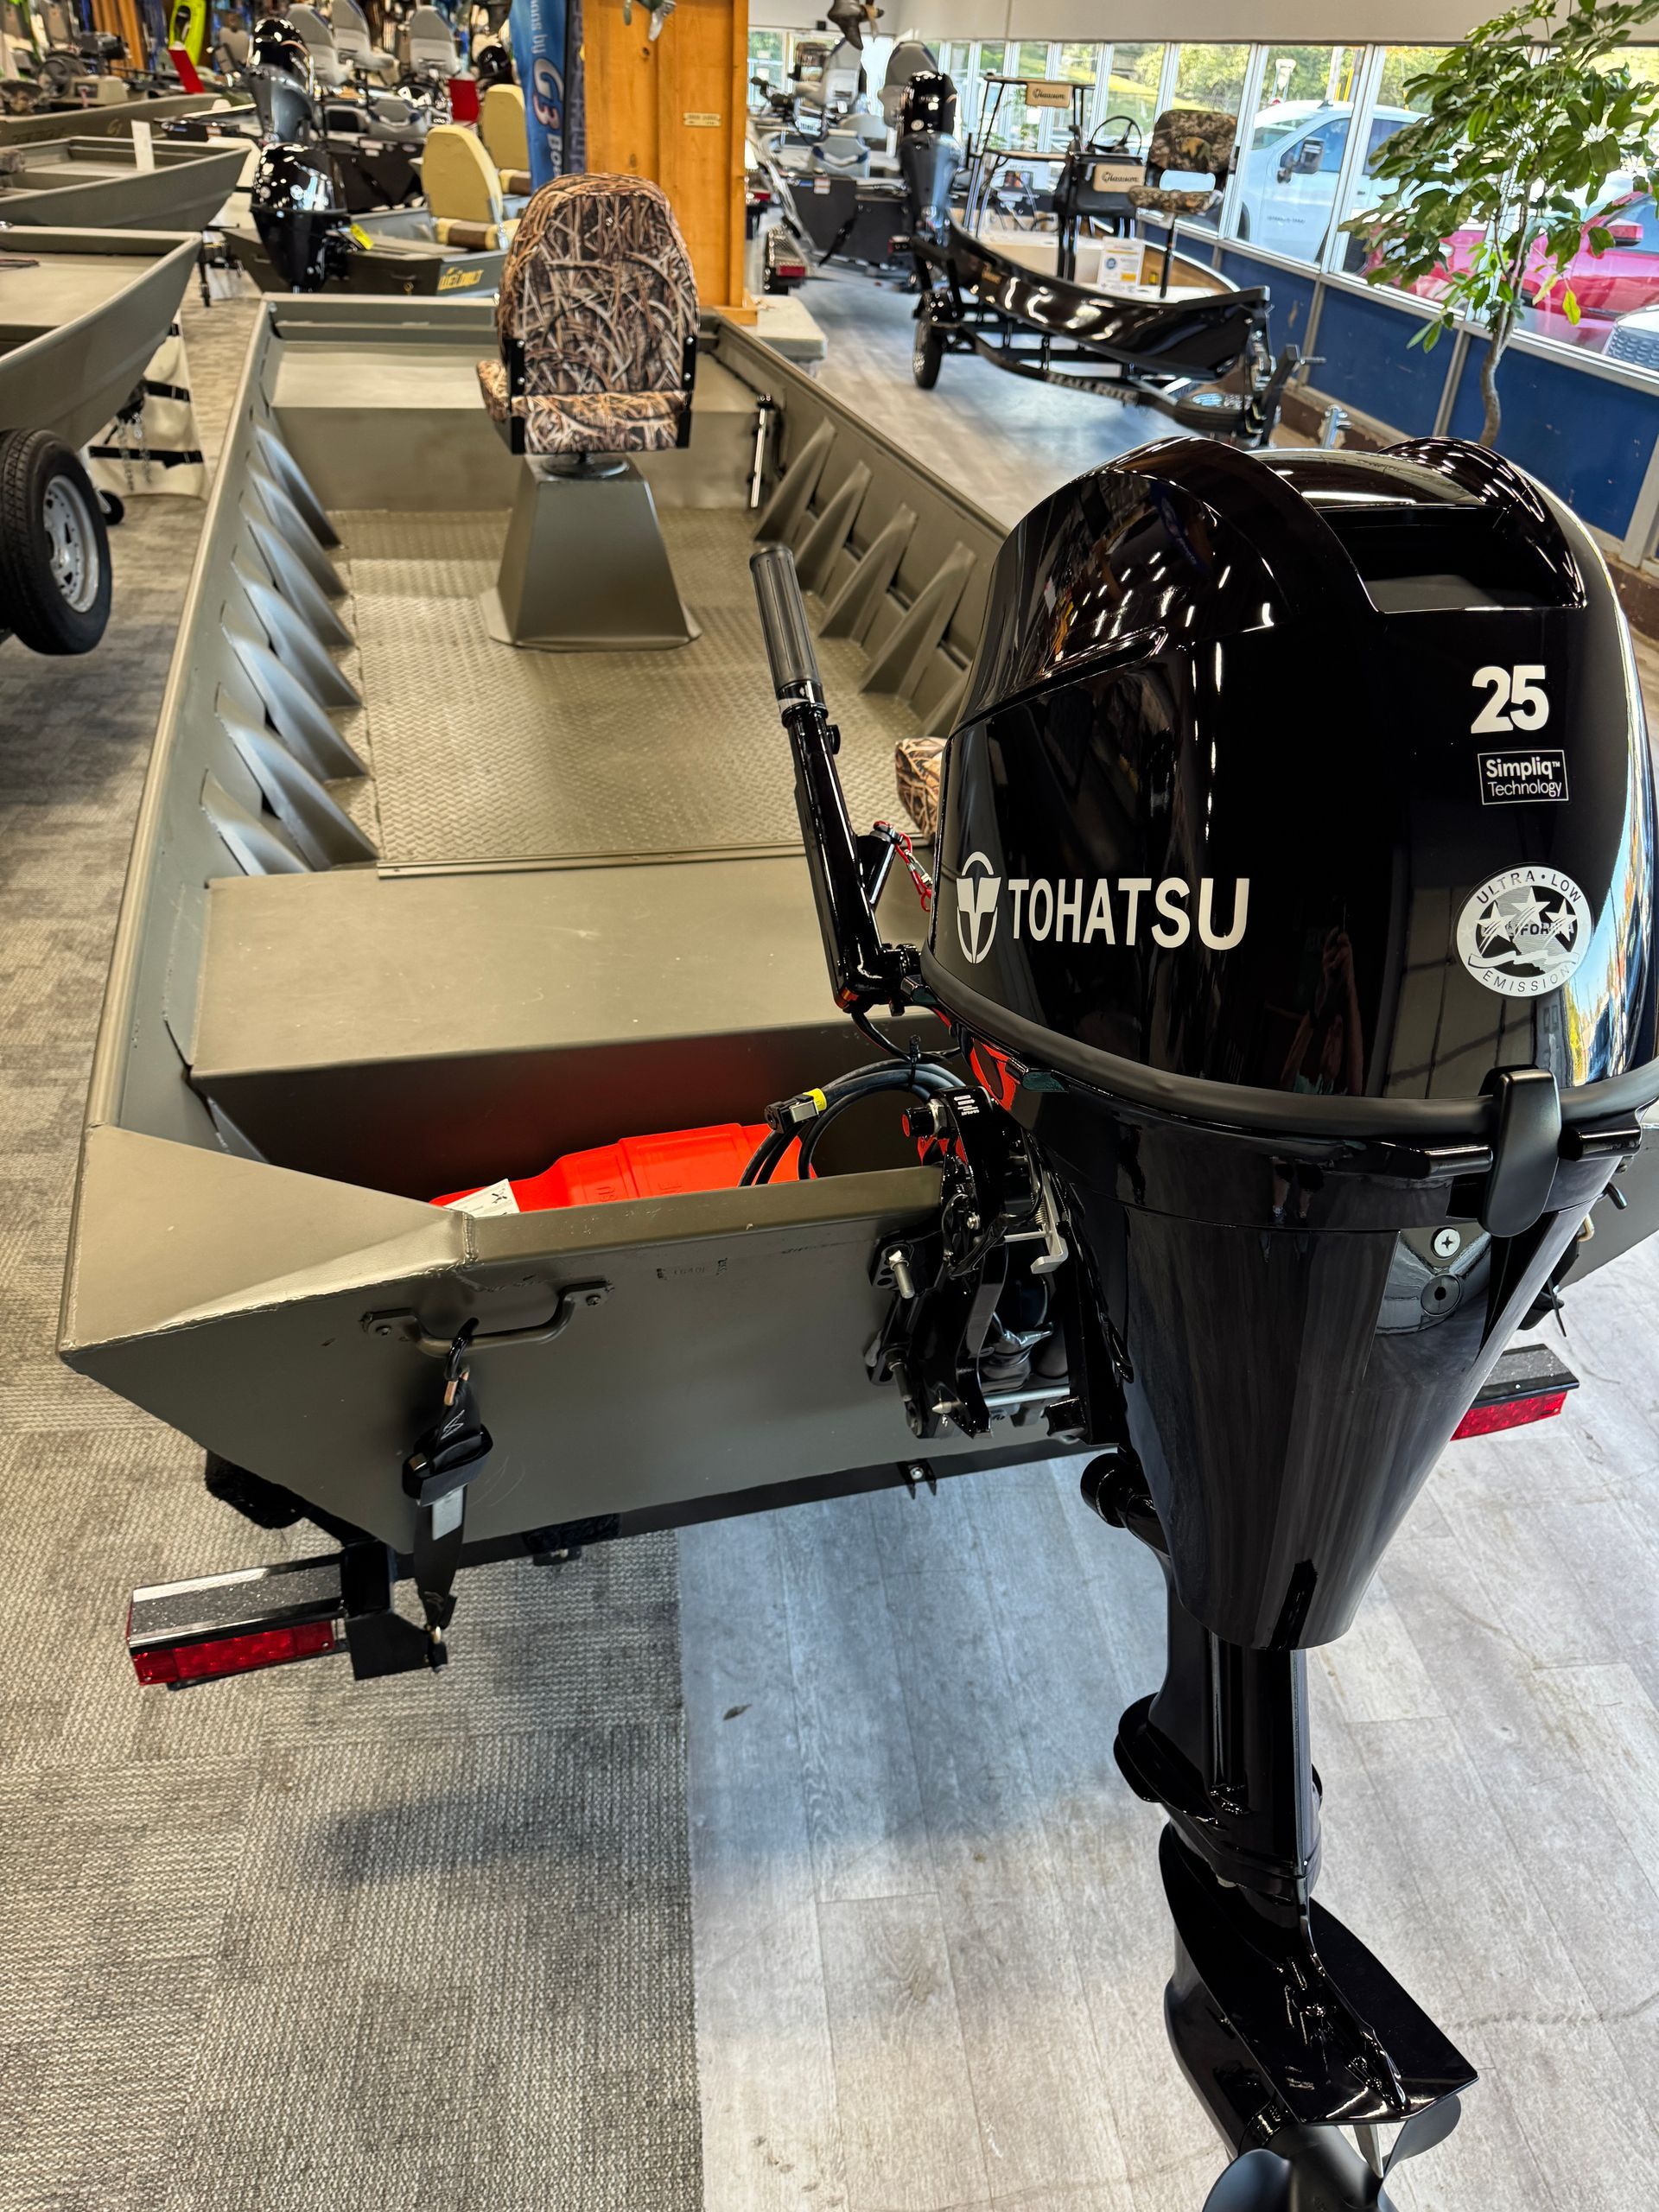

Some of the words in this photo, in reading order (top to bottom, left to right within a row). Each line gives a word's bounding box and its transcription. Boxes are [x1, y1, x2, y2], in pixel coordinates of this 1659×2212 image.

[531, 35, 548, 54] by
[533, 58, 565, 130] G3
[1471, 664, 1550, 734] 25
[1487, 779, 1562, 798] Technology
[1476, 869, 1536, 906] ULTRA
[1551, 873, 1582, 904] LOW
[1007, 877, 1250, 951] TOHATSU
[1482, 964, 1571, 993] EMISSION
